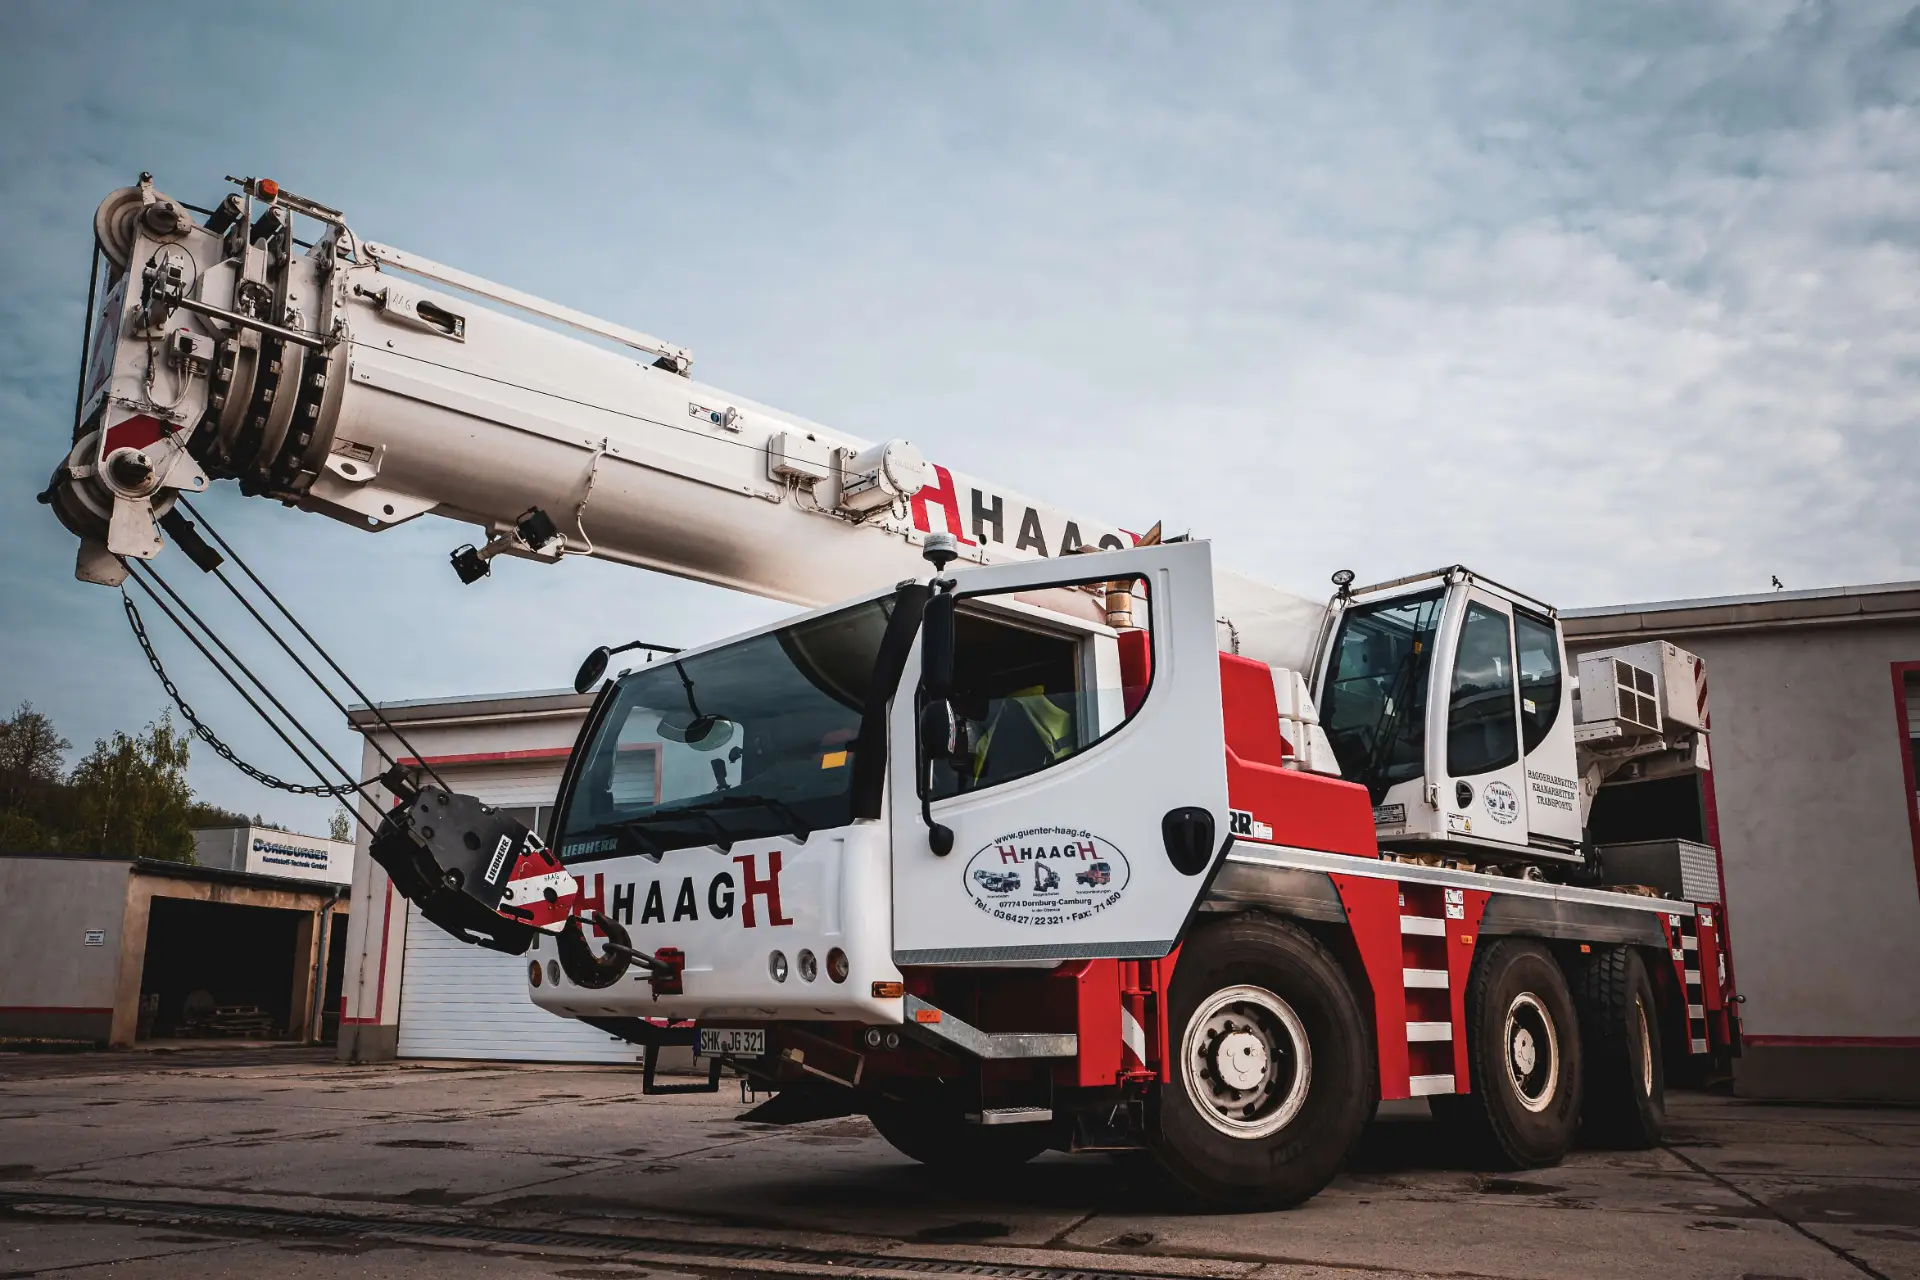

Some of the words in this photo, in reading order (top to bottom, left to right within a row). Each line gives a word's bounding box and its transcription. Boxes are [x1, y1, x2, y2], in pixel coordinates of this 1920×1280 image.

[1532, 782, 1575, 800] KRANARBEITEN
[1536, 795, 1573, 811] TRANSPORTS
[994, 825, 1091, 845] www.guenter-haag.de
[562, 838, 619, 857] LIEBHERR
[1020, 844, 1076, 860] HAAG
[311, 862, 328, 871] GmbH
[484, 838, 511, 883] LIEBHERR
[612, 871, 735, 926] HAAG
[1022, 898, 1092, 907] Dornburg-Camburg
[974, 897, 991, 913] Tel.:
[1071, 910, 1092, 921] Fax:
[701, 1030, 721, 1051] SHK
[728, 1031, 741, 1051] JG
[743, 1031, 764, 1052] 321
